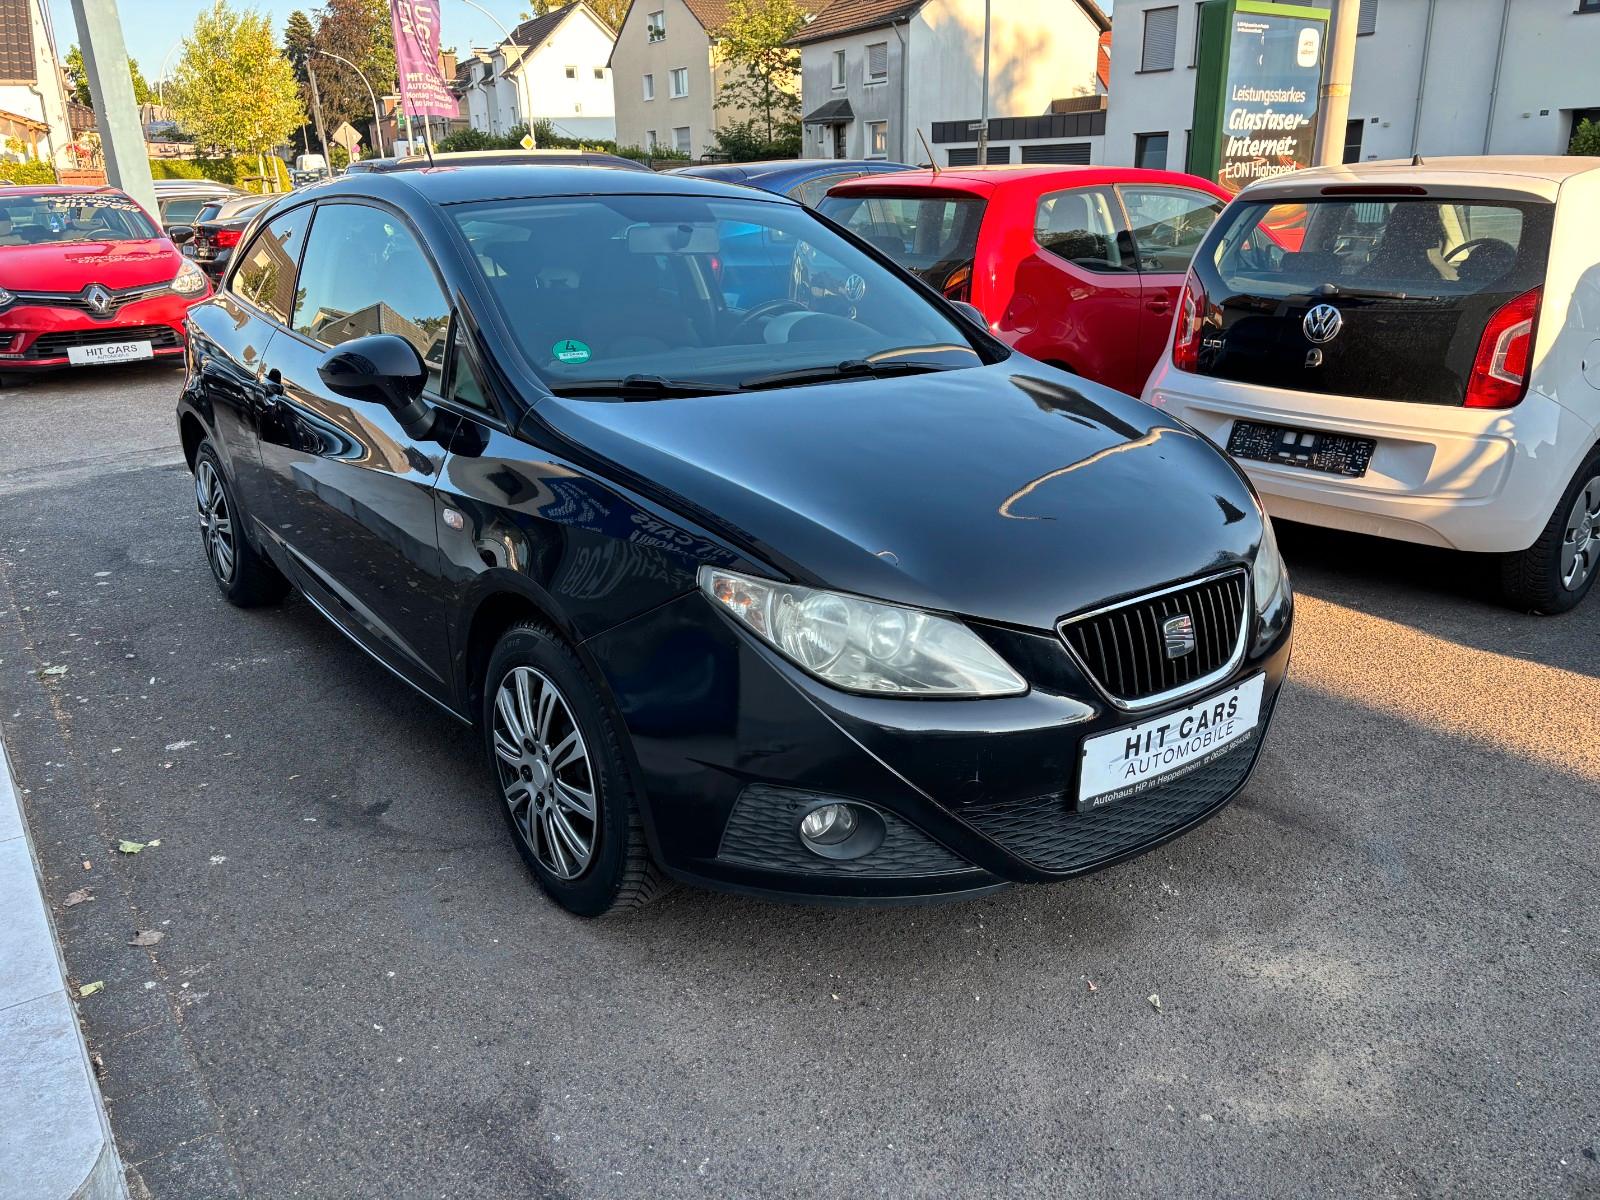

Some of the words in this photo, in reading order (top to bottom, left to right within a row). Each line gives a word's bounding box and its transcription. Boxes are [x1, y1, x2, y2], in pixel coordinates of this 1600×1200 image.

[406, 72, 423, 82] HIT
[1232, 84, 1306, 106] Leistungsstarkes
[1228, 108, 1310, 130] Glasfaser-
[1225, 135, 1298, 157] Internet:
[1225, 161, 1249, 179] E.ON
[86, 347, 103, 357] HIT
[107, 344, 138, 355] CARS
[565, 340, 577, 352] 4
[1124, 723, 1171, 760] HIT
[1180, 695, 1239, 739] CARS
[1124, 720, 1235, 779] AUTOMOBILE
[1092, 788, 1134, 807] Autohaus
[1134, 781, 1148, 793] HP
[1148, 779, 1156, 788] in
[1157, 760, 1201, 785] Heppenheim
